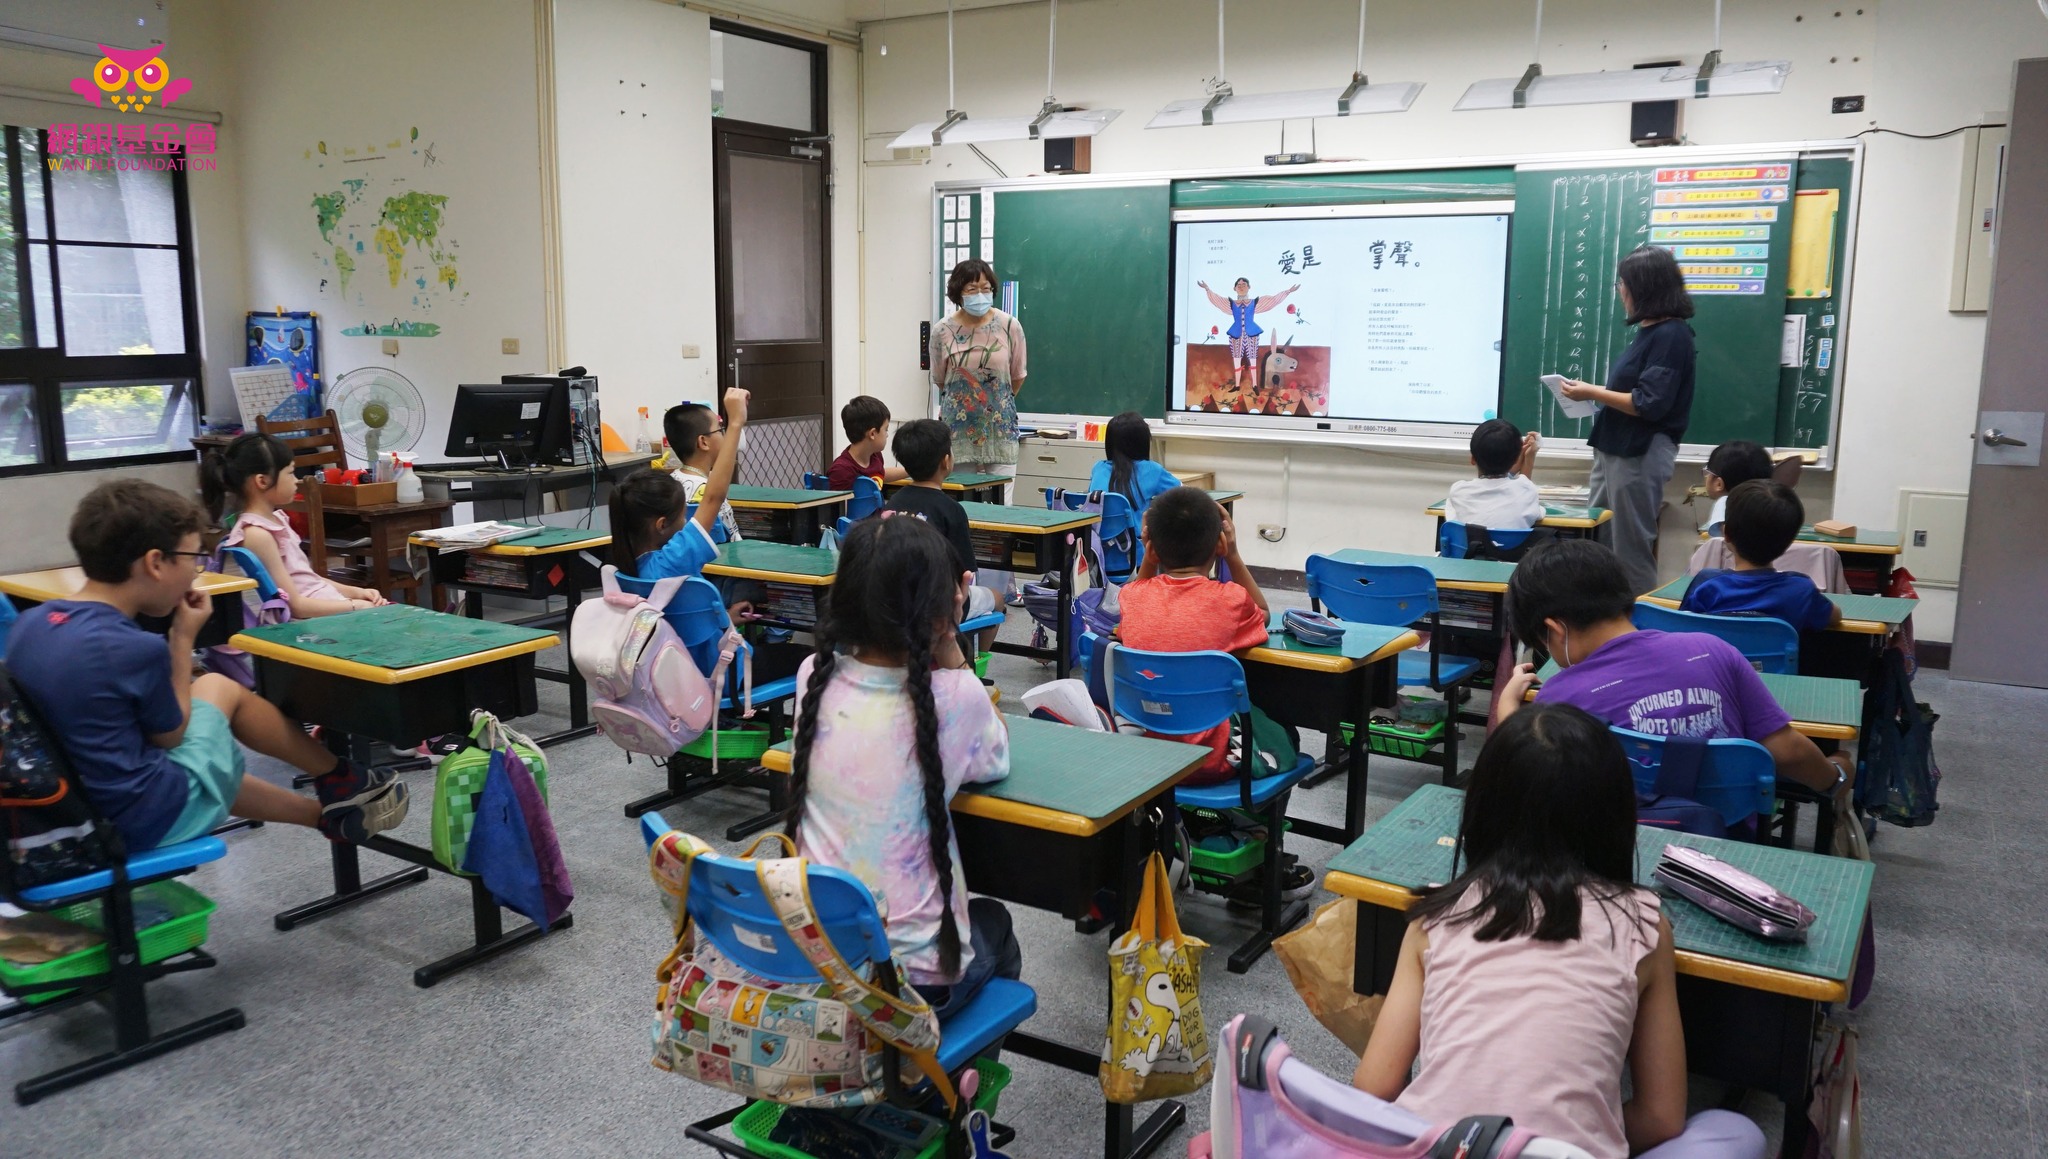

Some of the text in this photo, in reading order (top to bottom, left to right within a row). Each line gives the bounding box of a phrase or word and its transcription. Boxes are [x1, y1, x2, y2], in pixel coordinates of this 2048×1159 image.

[1278, 239, 1421, 275] 愛是 掌聲。
[1628, 689, 1683, 721] UNTURNED
[1182, 1007, 1200, 1028] DOG
